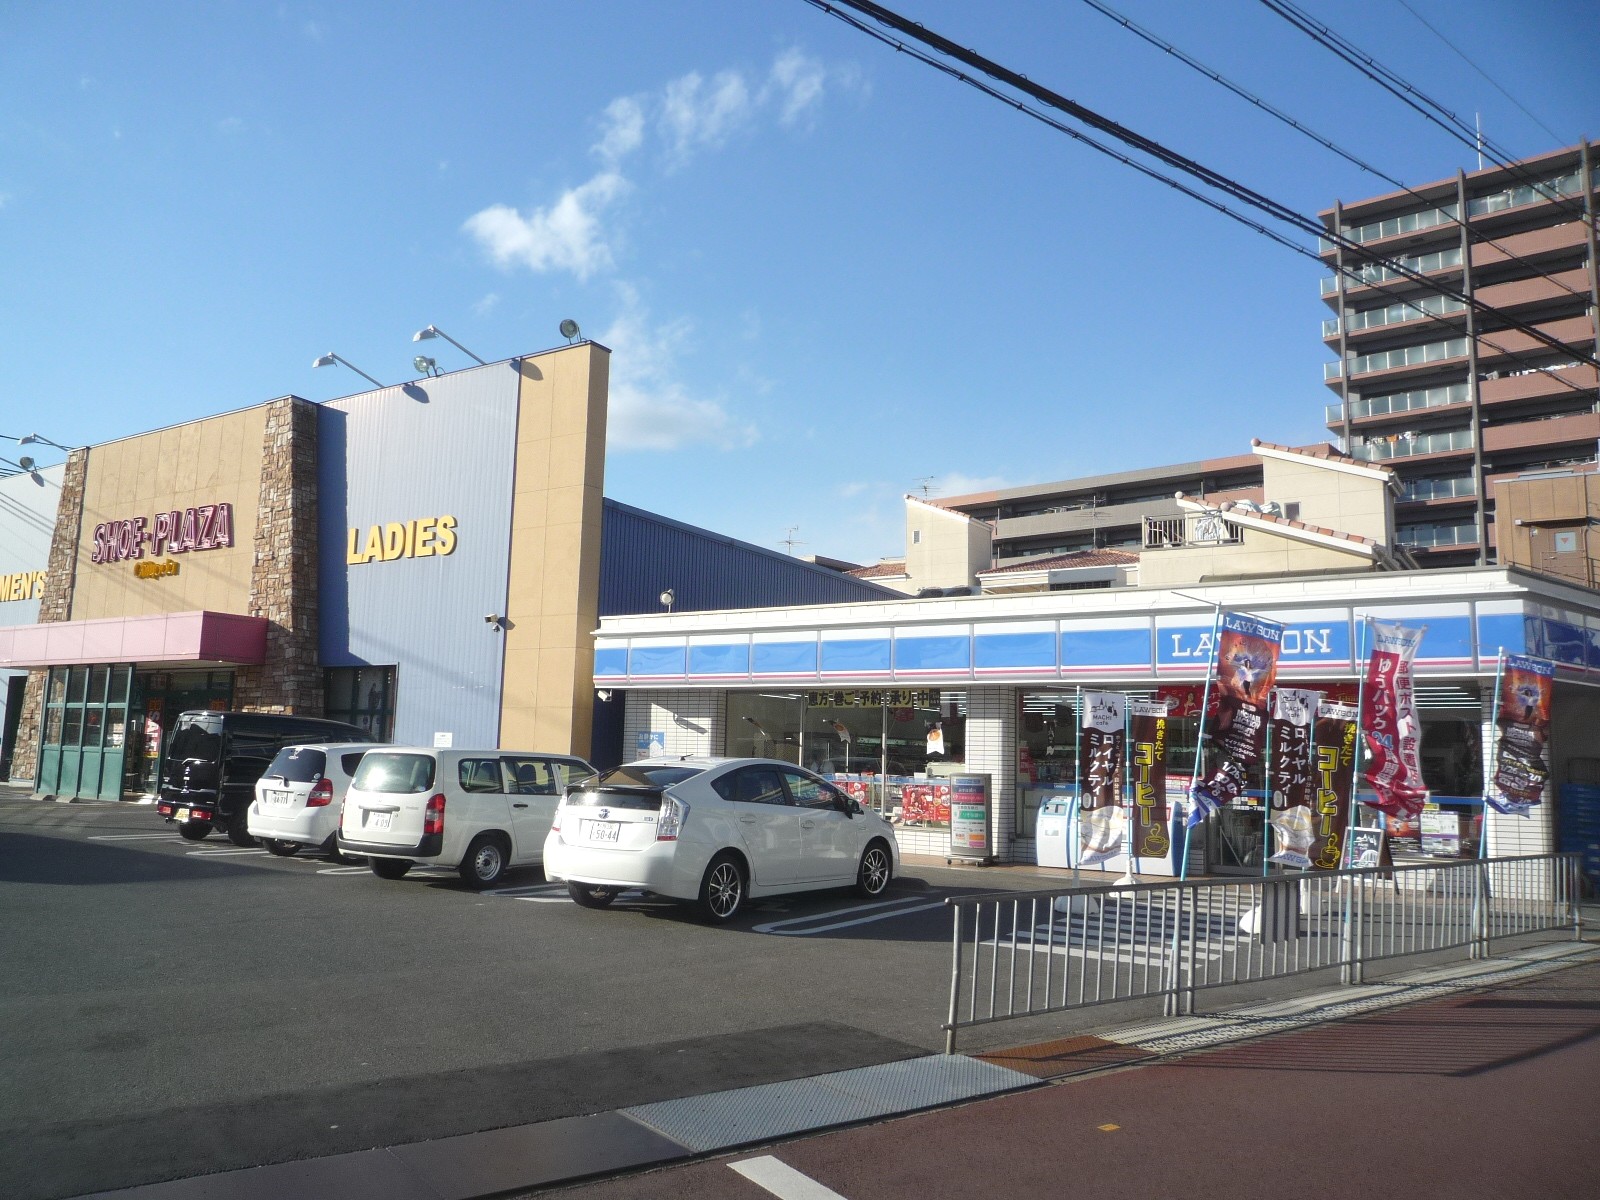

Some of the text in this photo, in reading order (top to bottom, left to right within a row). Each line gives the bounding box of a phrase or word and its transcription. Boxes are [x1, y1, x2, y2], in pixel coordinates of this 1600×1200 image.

[346, 515, 458, 565] LADIES
[1171, 629, 1333, 657] LAON
[1225, 616, 1281, 641] LAWSON
[808, 689, 929, 706] 恵方巻ご予約承り中
[1134, 706, 1166, 714] LAWSON
[1320, 707, 1358, 718] LAWSON
[1101, 734, 1114, 786] ロイヤル
[1155, 719, 1165, 760] 挽きたて
[1291, 727, 1306, 784] ロイヤル
[1088, 733, 1101, 807] ミルクティー
[1135, 742, 1156, 827] コーヒー
[1278, 726, 1292, 807] ミルクティー
[1317, 746, 1339, 836] コーヒー
